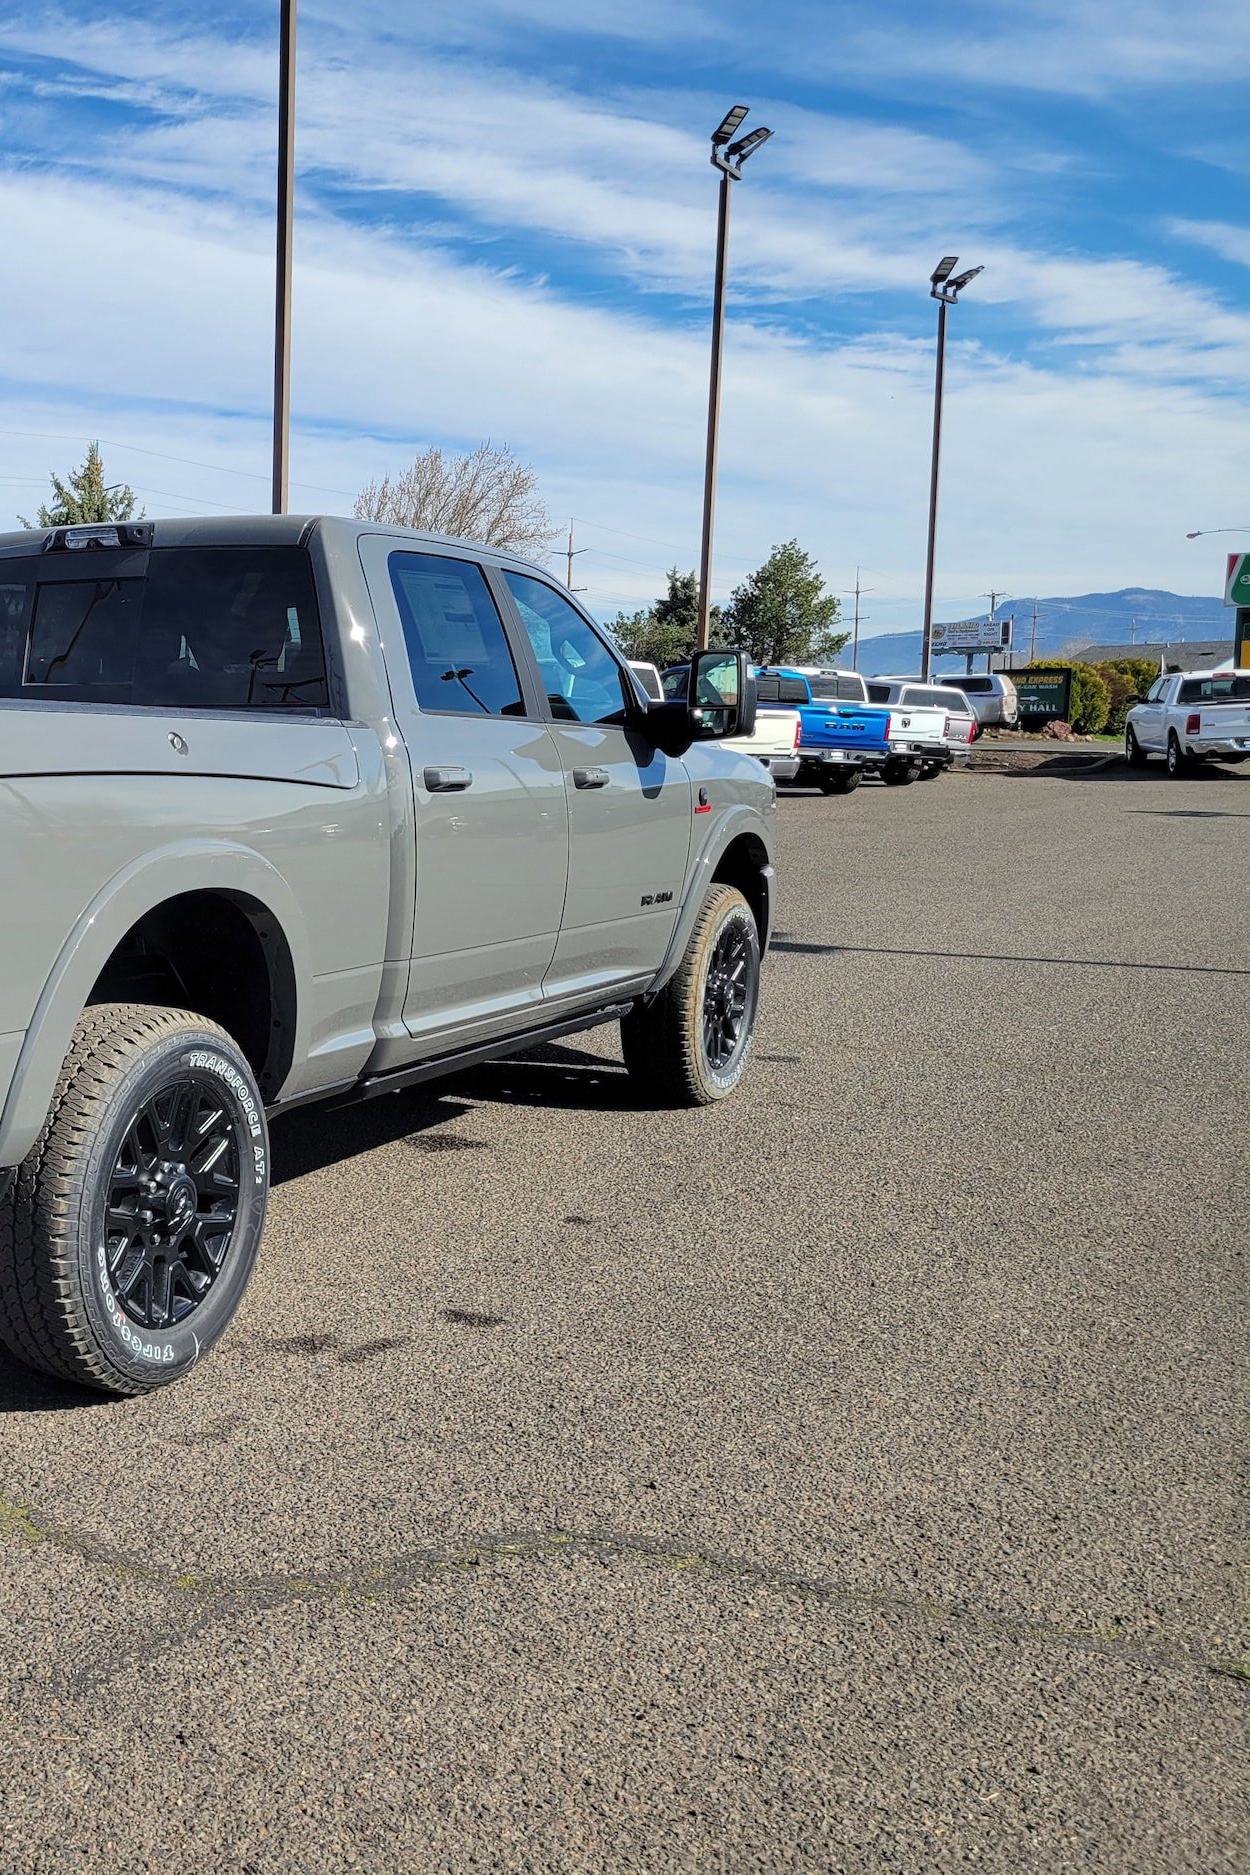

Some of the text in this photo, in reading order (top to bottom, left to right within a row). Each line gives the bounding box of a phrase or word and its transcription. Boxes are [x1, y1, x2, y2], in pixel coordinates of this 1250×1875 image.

[1029, 676, 1064, 684] EXPRESS
[1029, 704, 1058, 712] HALL
[824, 721, 865, 731] RAM
[189, 1052, 262, 1138] TRANSFORCE
